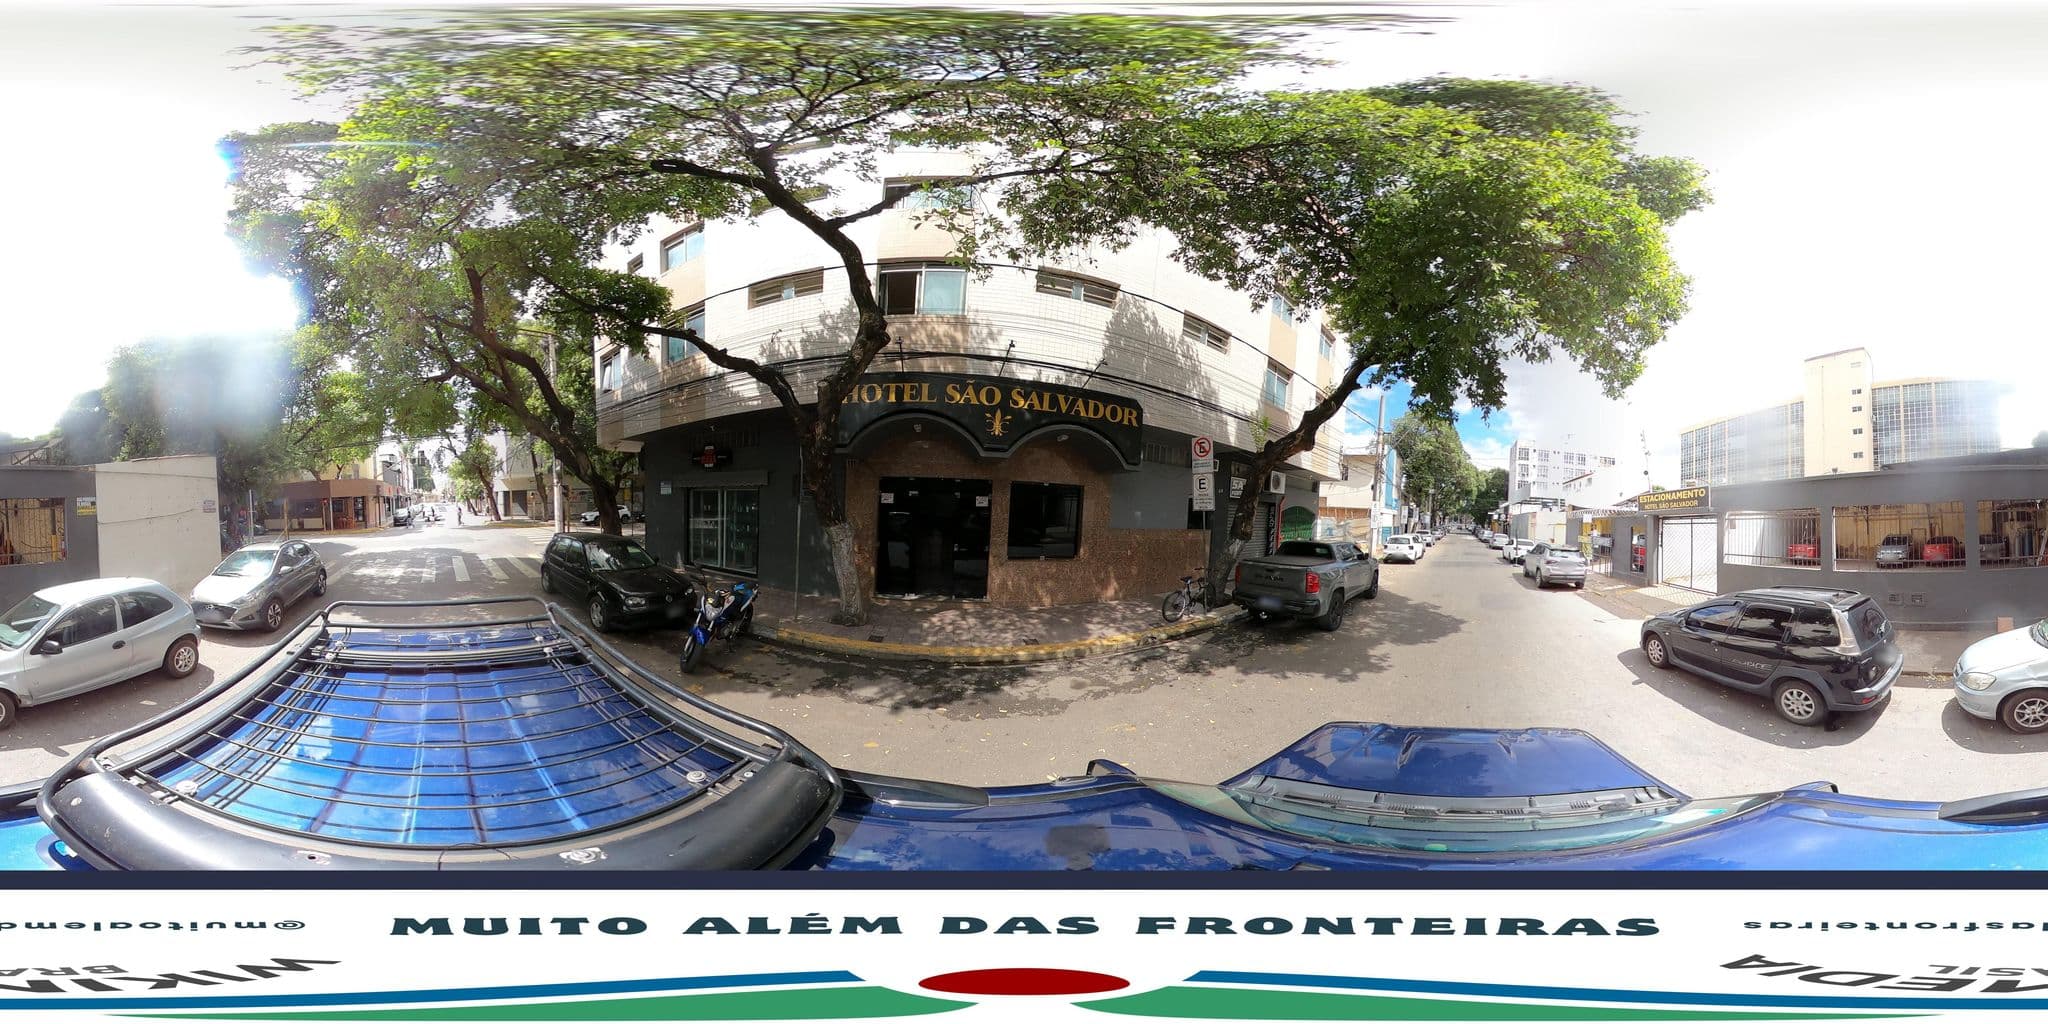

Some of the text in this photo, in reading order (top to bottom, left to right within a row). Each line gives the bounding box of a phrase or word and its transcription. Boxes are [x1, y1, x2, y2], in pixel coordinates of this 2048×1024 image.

[842, 379, 1139, 427] HOTEL SÃO SALVADOR
[1198, 478, 1207, 490] E
[1639, 489, 1706, 503] ESTACIONAMENTO
[1644, 500, 1698, 510] HOTEL SÃO SALVADOR
